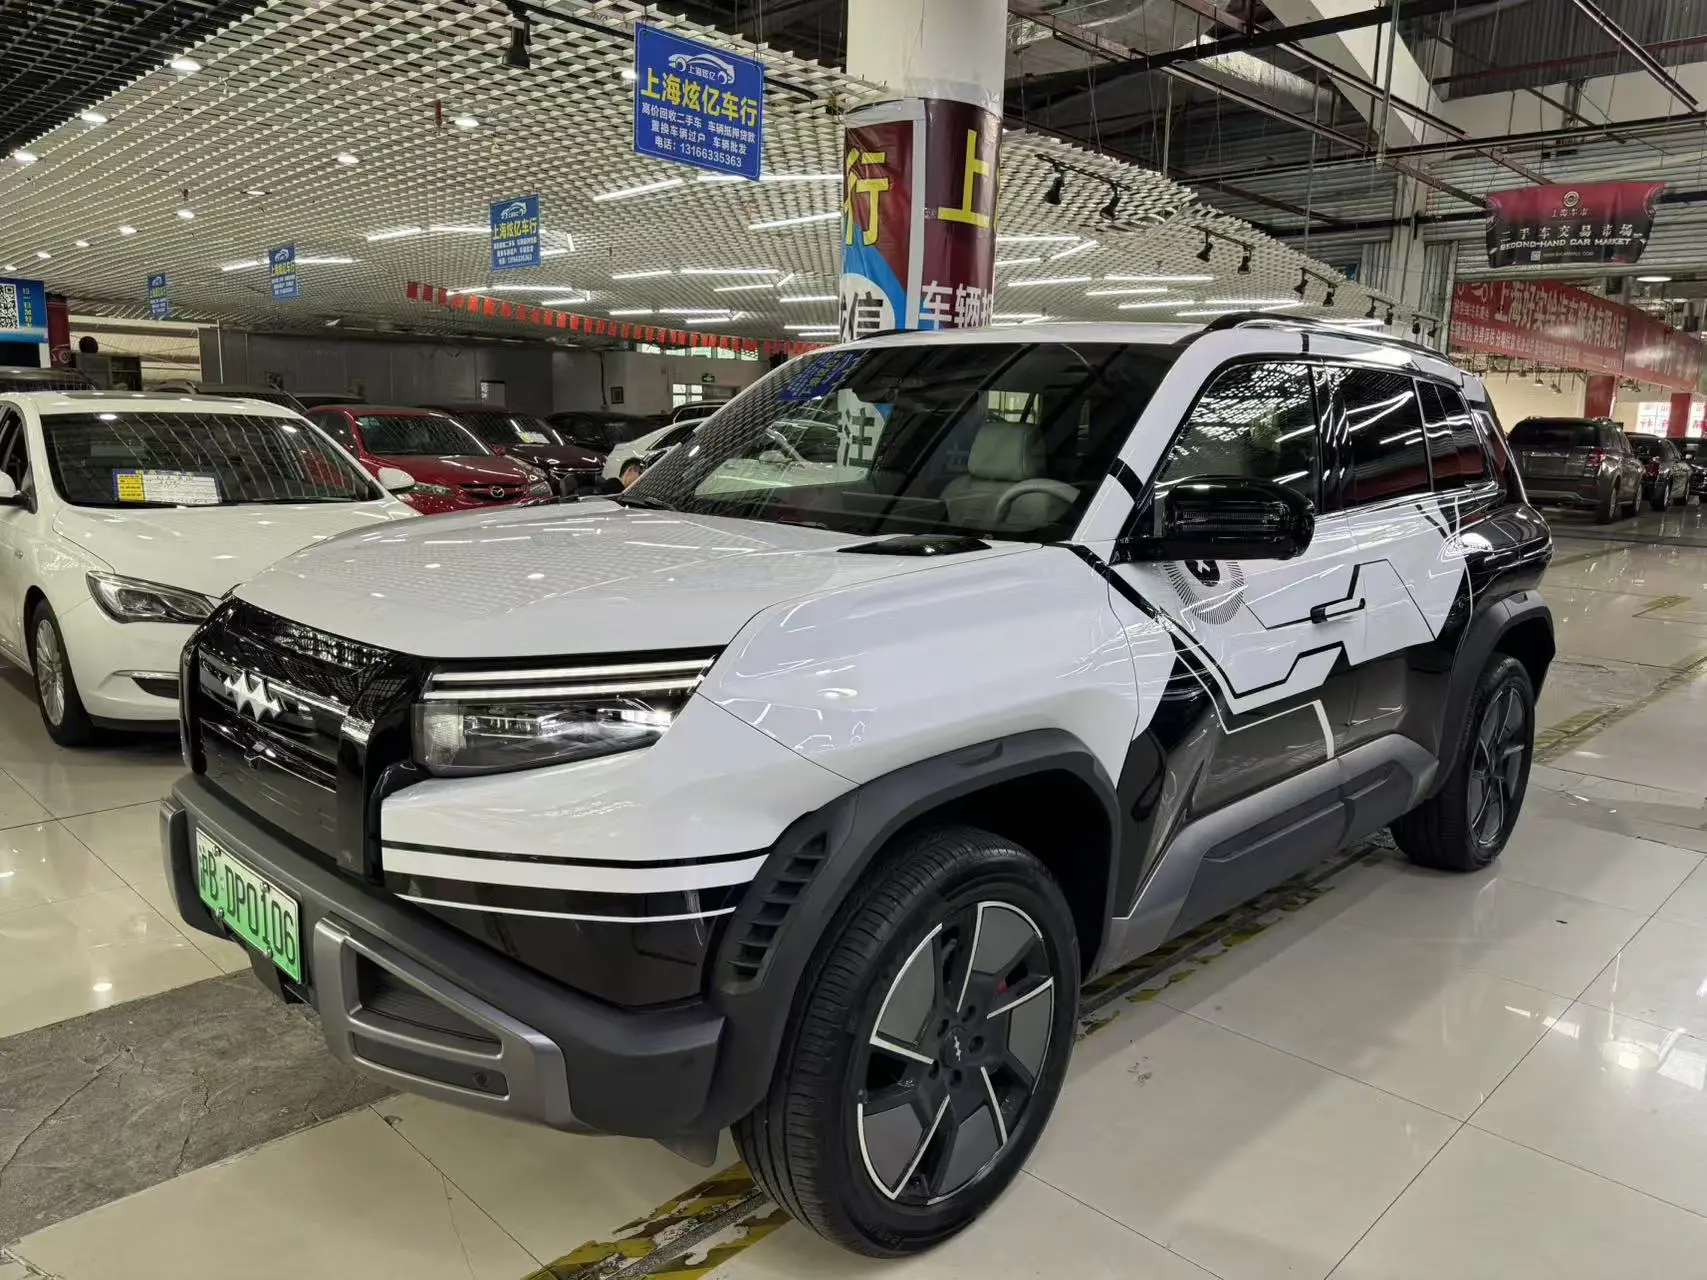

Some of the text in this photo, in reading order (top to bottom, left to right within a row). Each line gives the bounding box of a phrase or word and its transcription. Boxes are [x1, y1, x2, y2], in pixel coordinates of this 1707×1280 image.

[641, 67, 758, 127] 上海炫亿车行
[641, 101, 756, 144] 高价回收二手车 车辆抵押贷款
[651, 119, 747, 155] 置换车辆过户 车辆批发
[845, 147, 890, 246] 行
[937, 128, 991, 229] 上
[1569, 237, 1592, 247] CAR
